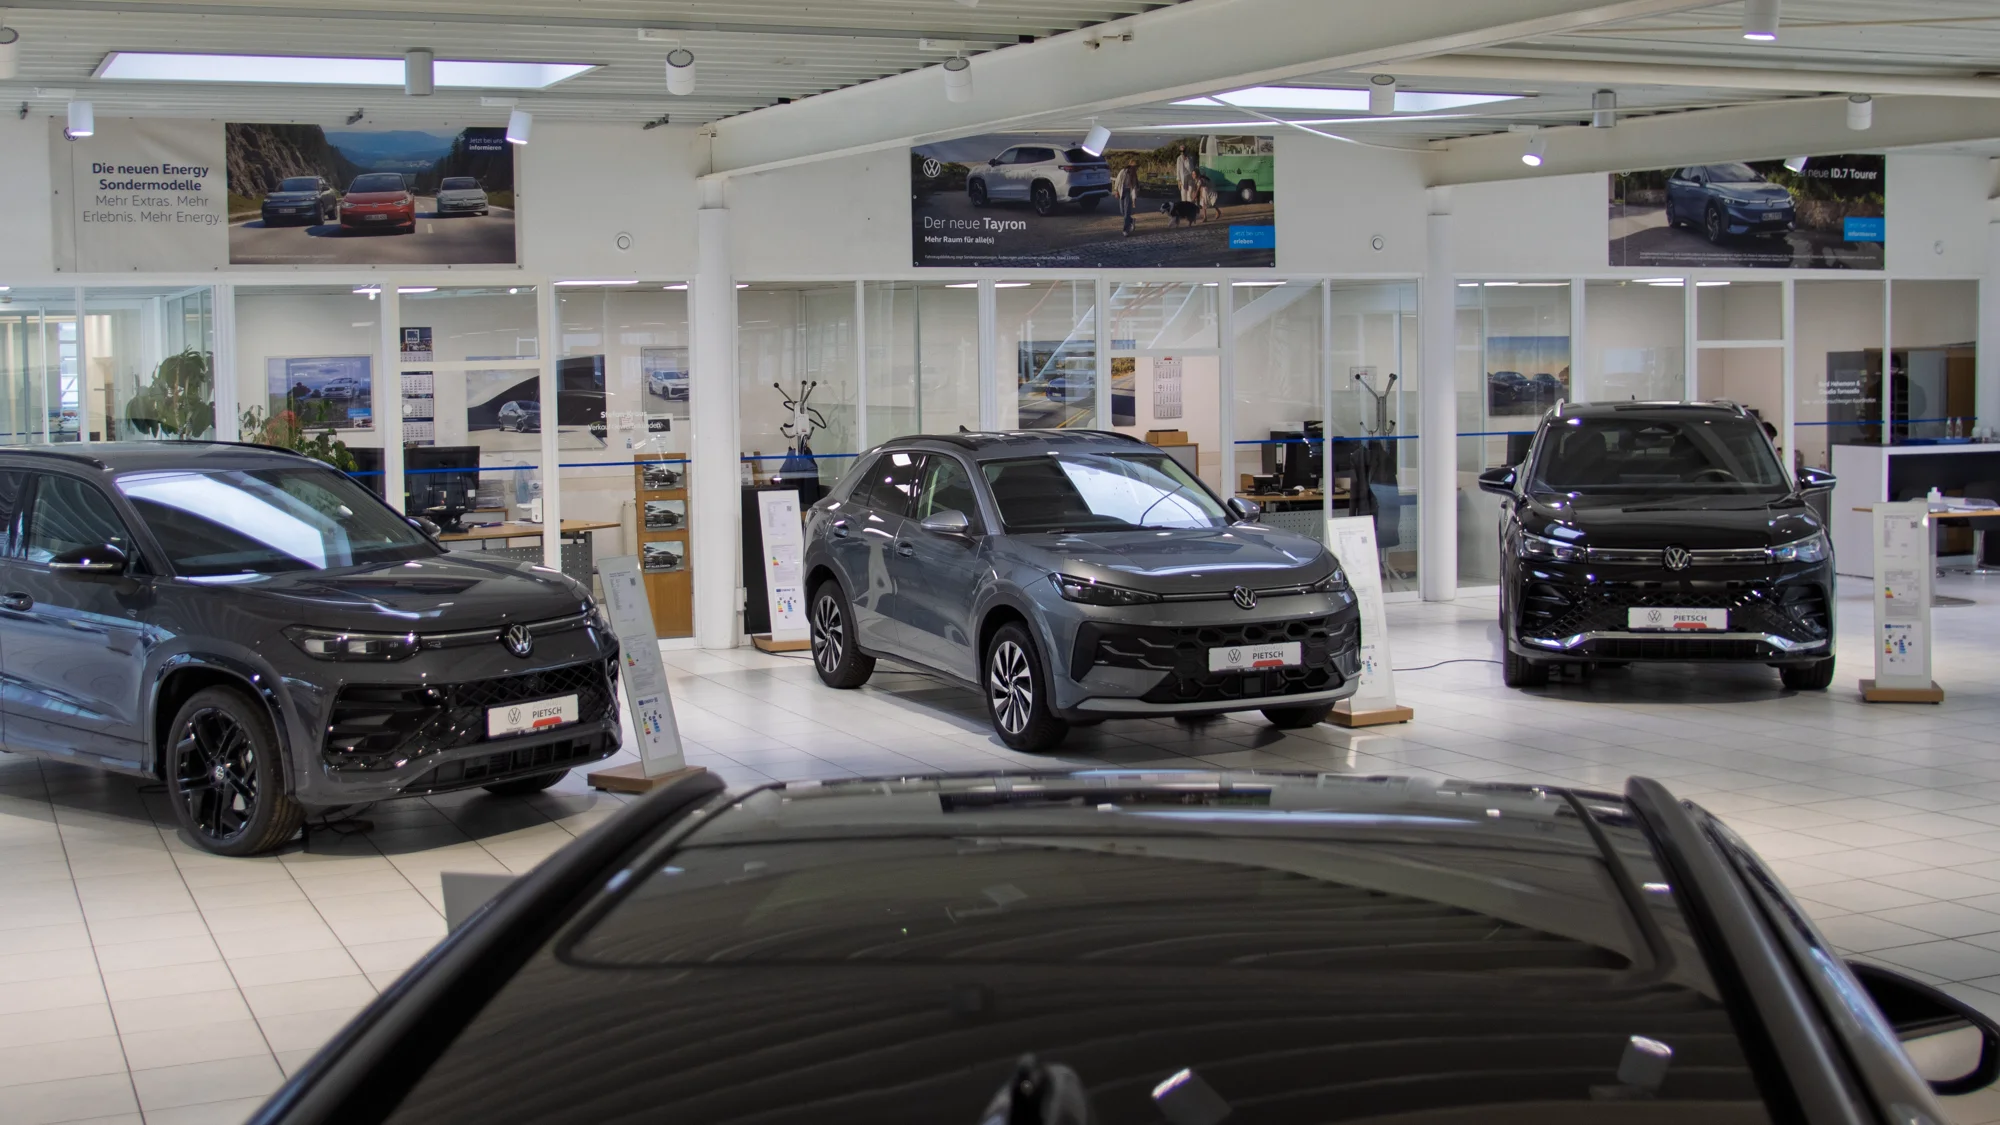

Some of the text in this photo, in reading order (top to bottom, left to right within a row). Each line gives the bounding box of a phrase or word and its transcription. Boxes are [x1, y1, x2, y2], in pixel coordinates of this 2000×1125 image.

[92, 162, 209, 178] Die neuen Energy
[1808, 169, 1830, 178] neue
[1831, 168, 1848, 178] ID.7
[1850, 168, 1878, 179] Tourer
[99, 179, 202, 191] Sondermodelle
[96, 195, 209, 207] Mehr Extras. Mehr
[83, 210, 222, 226] Erlebnis. Mehr Energy.
[924, 216, 1026, 233] Der neue Tayron
[975, 236, 995, 244] alle(s)
[1252, 651, 1284, 660] PIETSCH
[532, 707, 562, 718] PIETSCH
